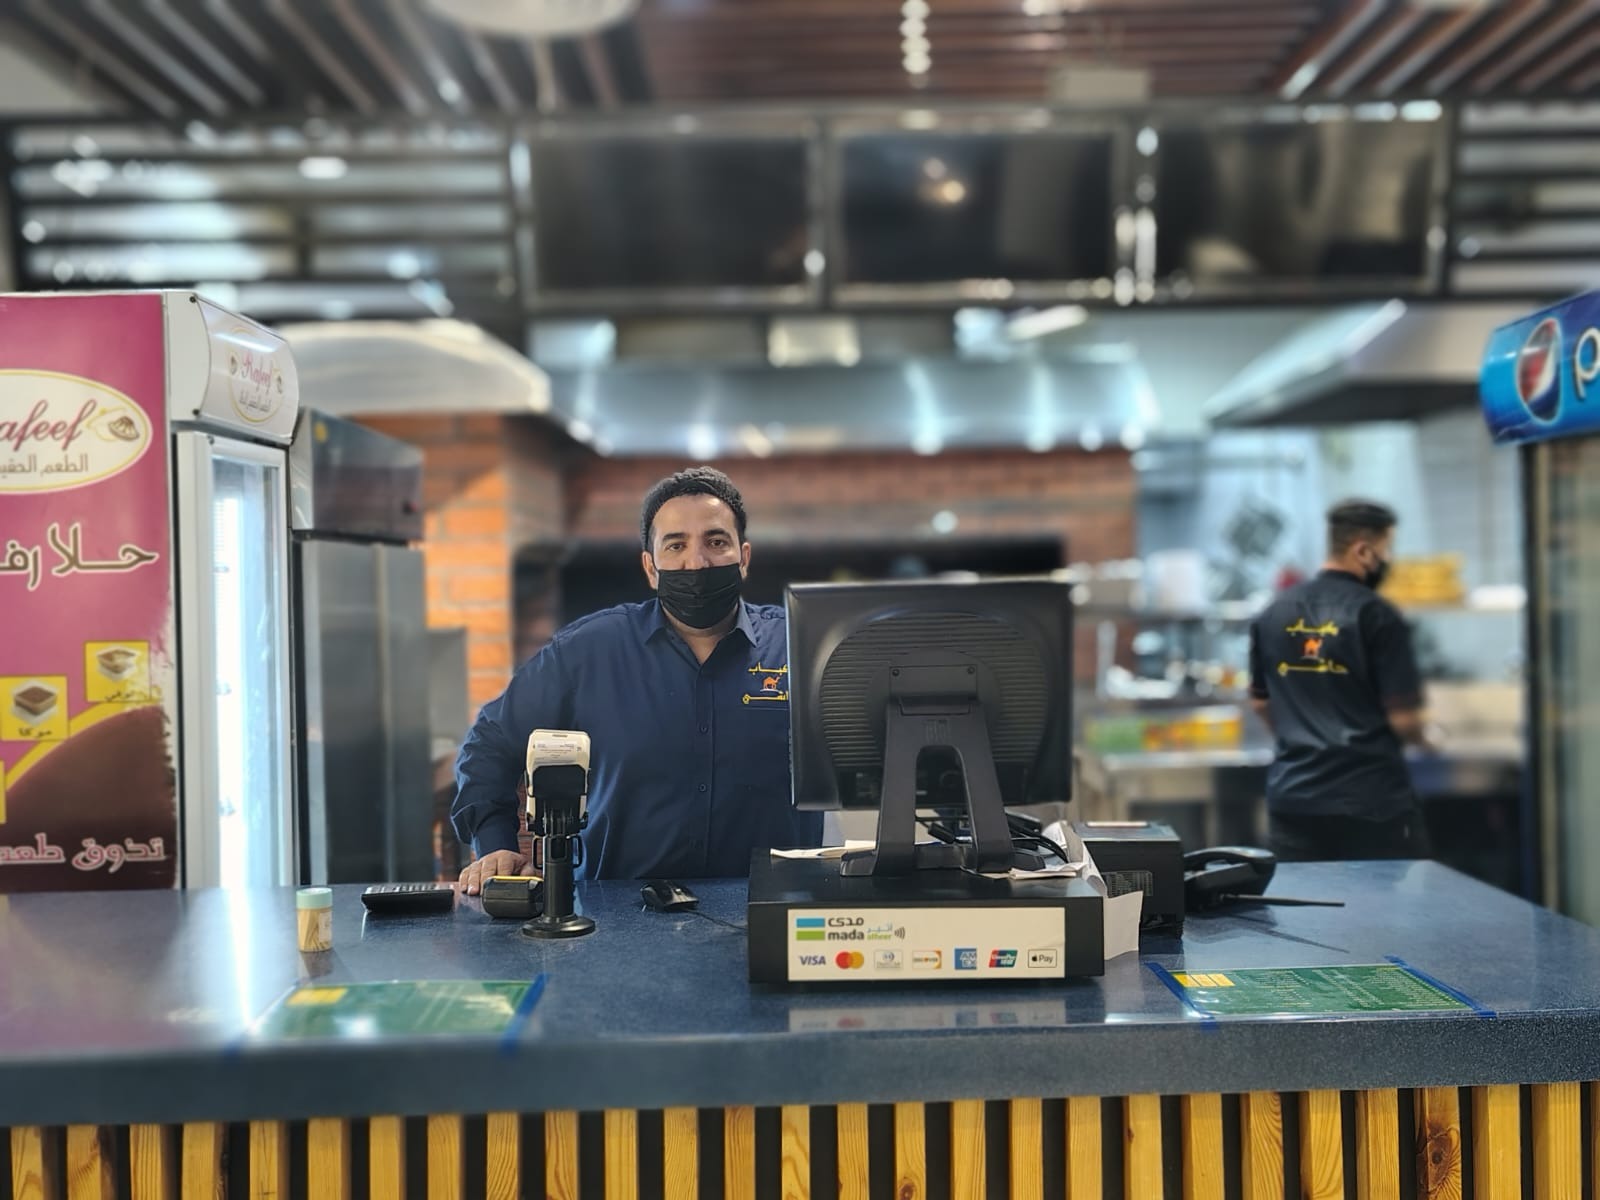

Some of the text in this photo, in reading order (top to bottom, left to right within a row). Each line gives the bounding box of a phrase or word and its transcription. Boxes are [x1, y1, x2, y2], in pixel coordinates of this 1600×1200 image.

[0, 399, 97, 452] afeef
[40, 453, 89, 477] الطعم
[0, 521, 160, 591] حلا رف
[71, 836, 167, 874] تذوق
[827, 916, 865, 928] مدى
[827, 928, 865, 941] mada
[799, 955, 827, 966] VISA
[1038, 954, 1054, 964] Pay
